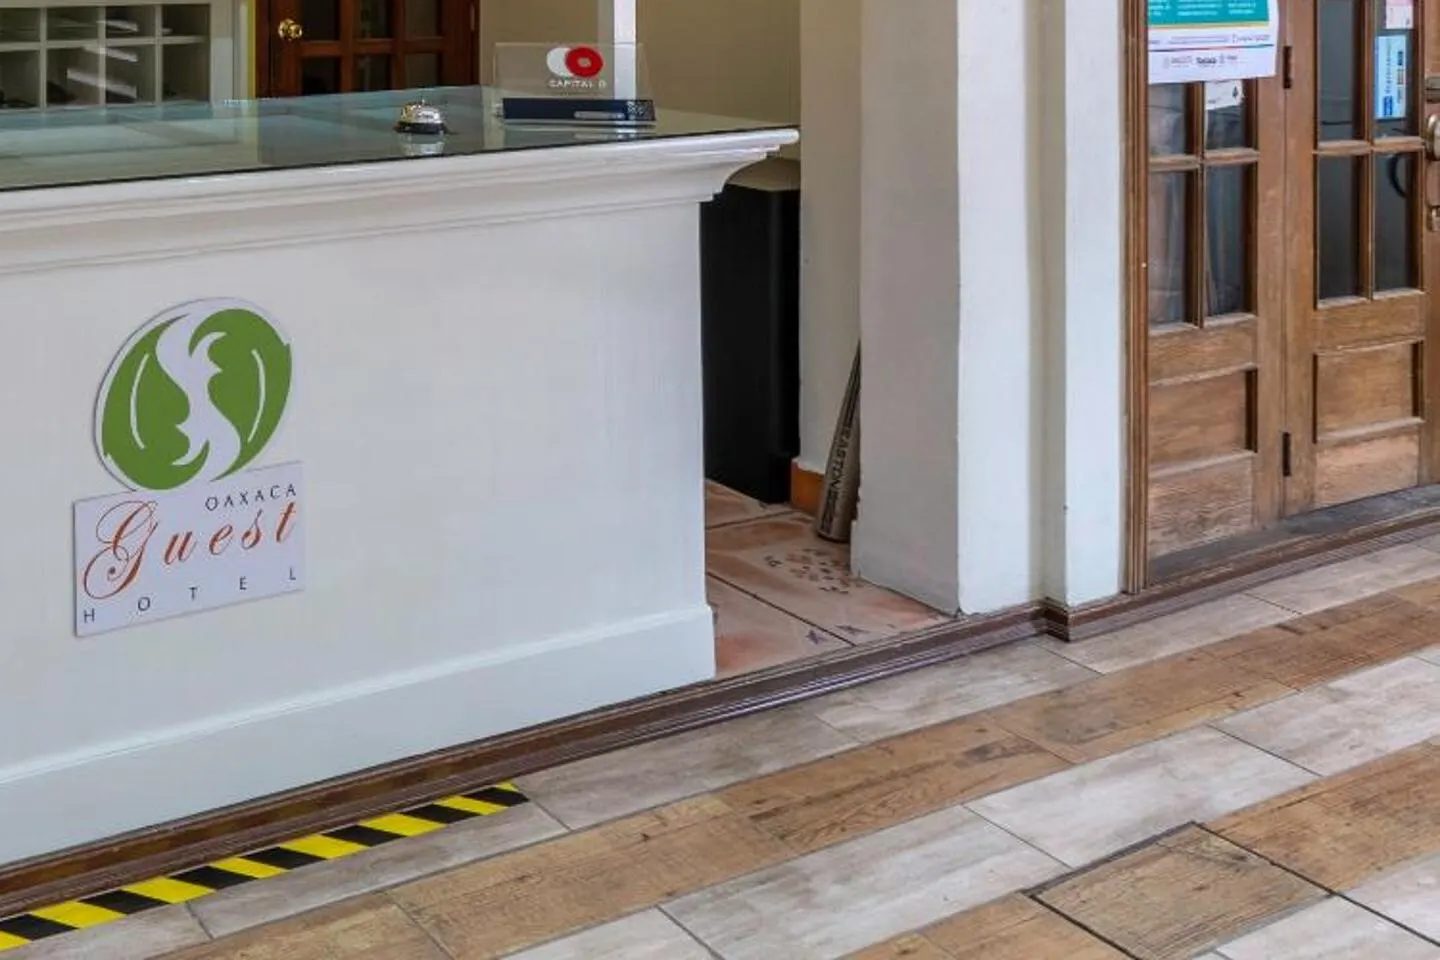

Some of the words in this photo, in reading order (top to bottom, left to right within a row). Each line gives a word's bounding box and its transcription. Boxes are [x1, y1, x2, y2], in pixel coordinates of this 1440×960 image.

[548, 78, 593, 89] CAPITAL
[204, 483, 297, 512] OAXACA
[82, 500, 298, 600] Guest
[82, 567, 297, 623] HOTEL
